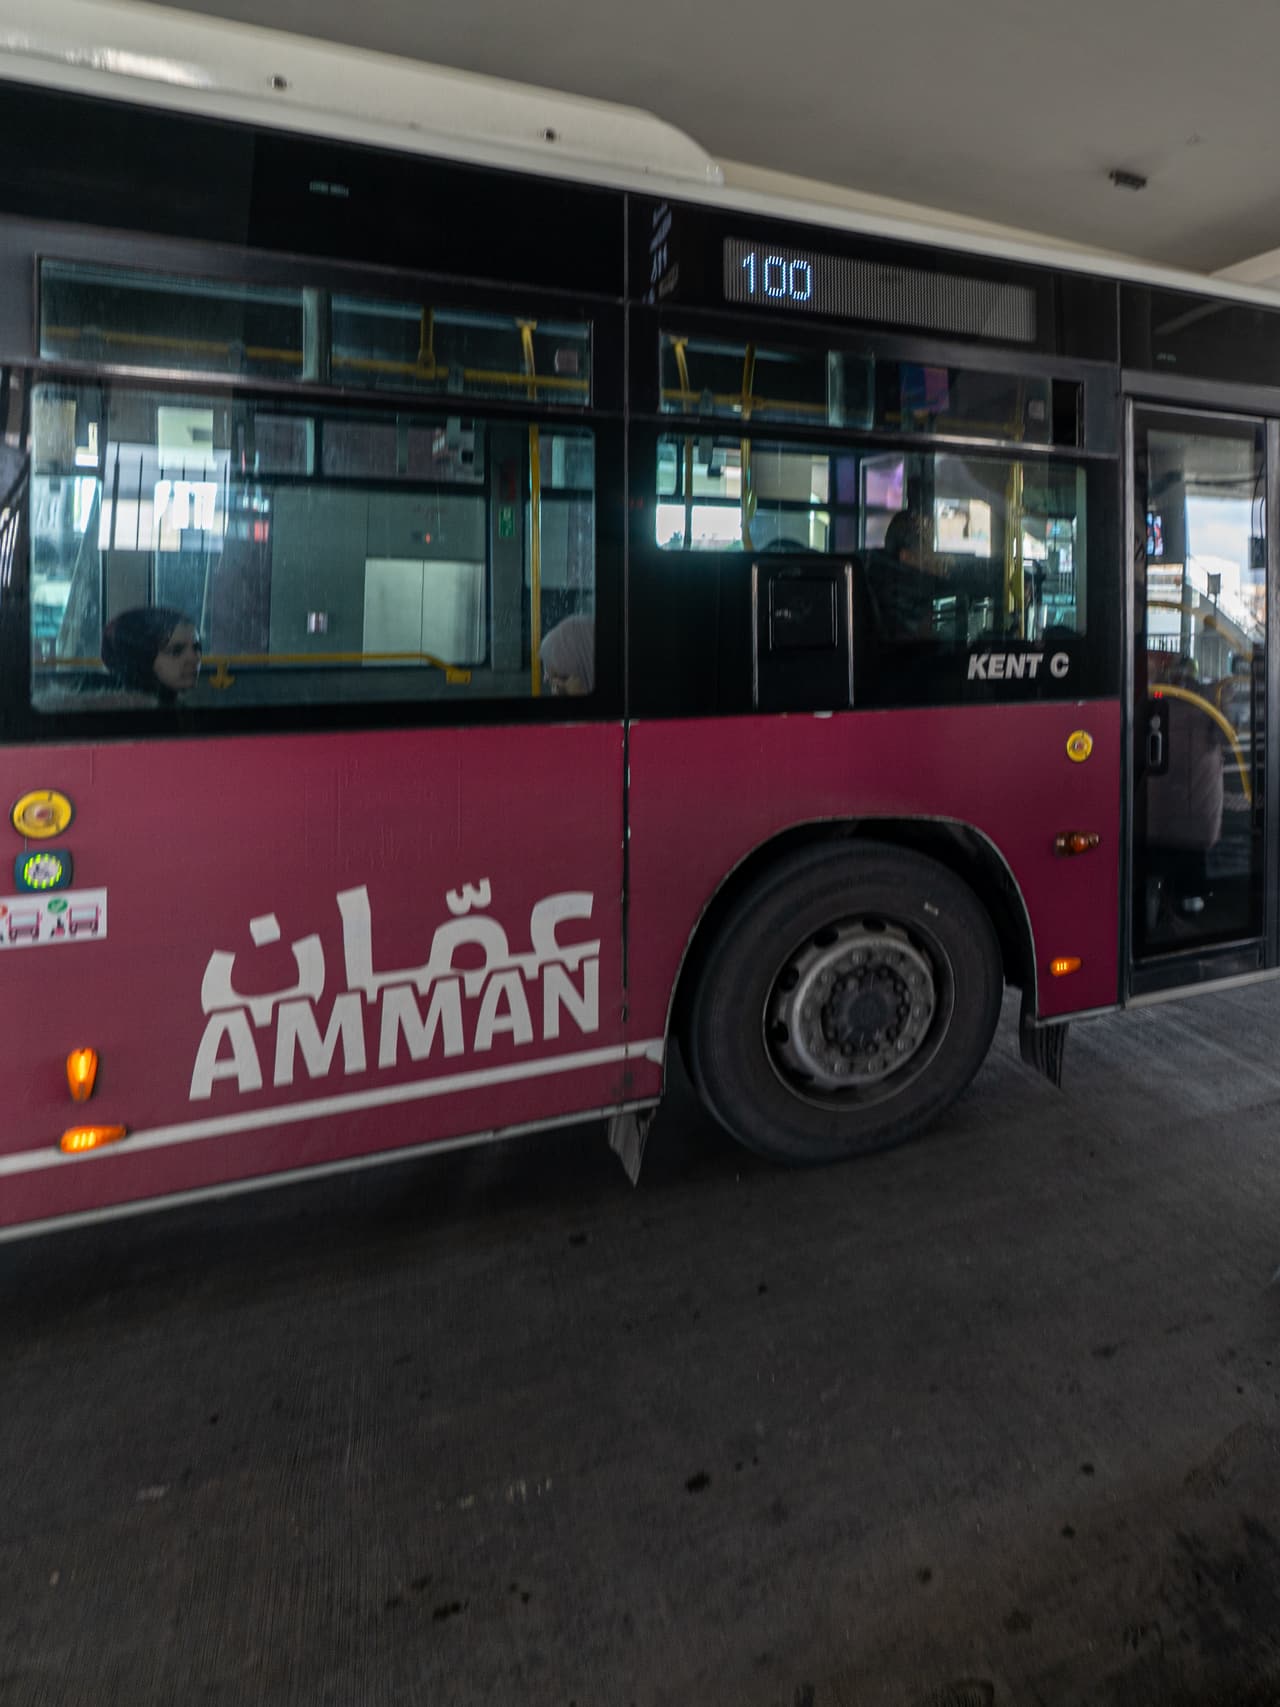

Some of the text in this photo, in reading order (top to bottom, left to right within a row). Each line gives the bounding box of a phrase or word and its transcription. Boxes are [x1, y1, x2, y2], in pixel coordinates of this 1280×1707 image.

[742, 251, 812, 301] 100
[967, 652, 1070, 680] KENT C
[188, 957, 600, 1100] AMMAN
